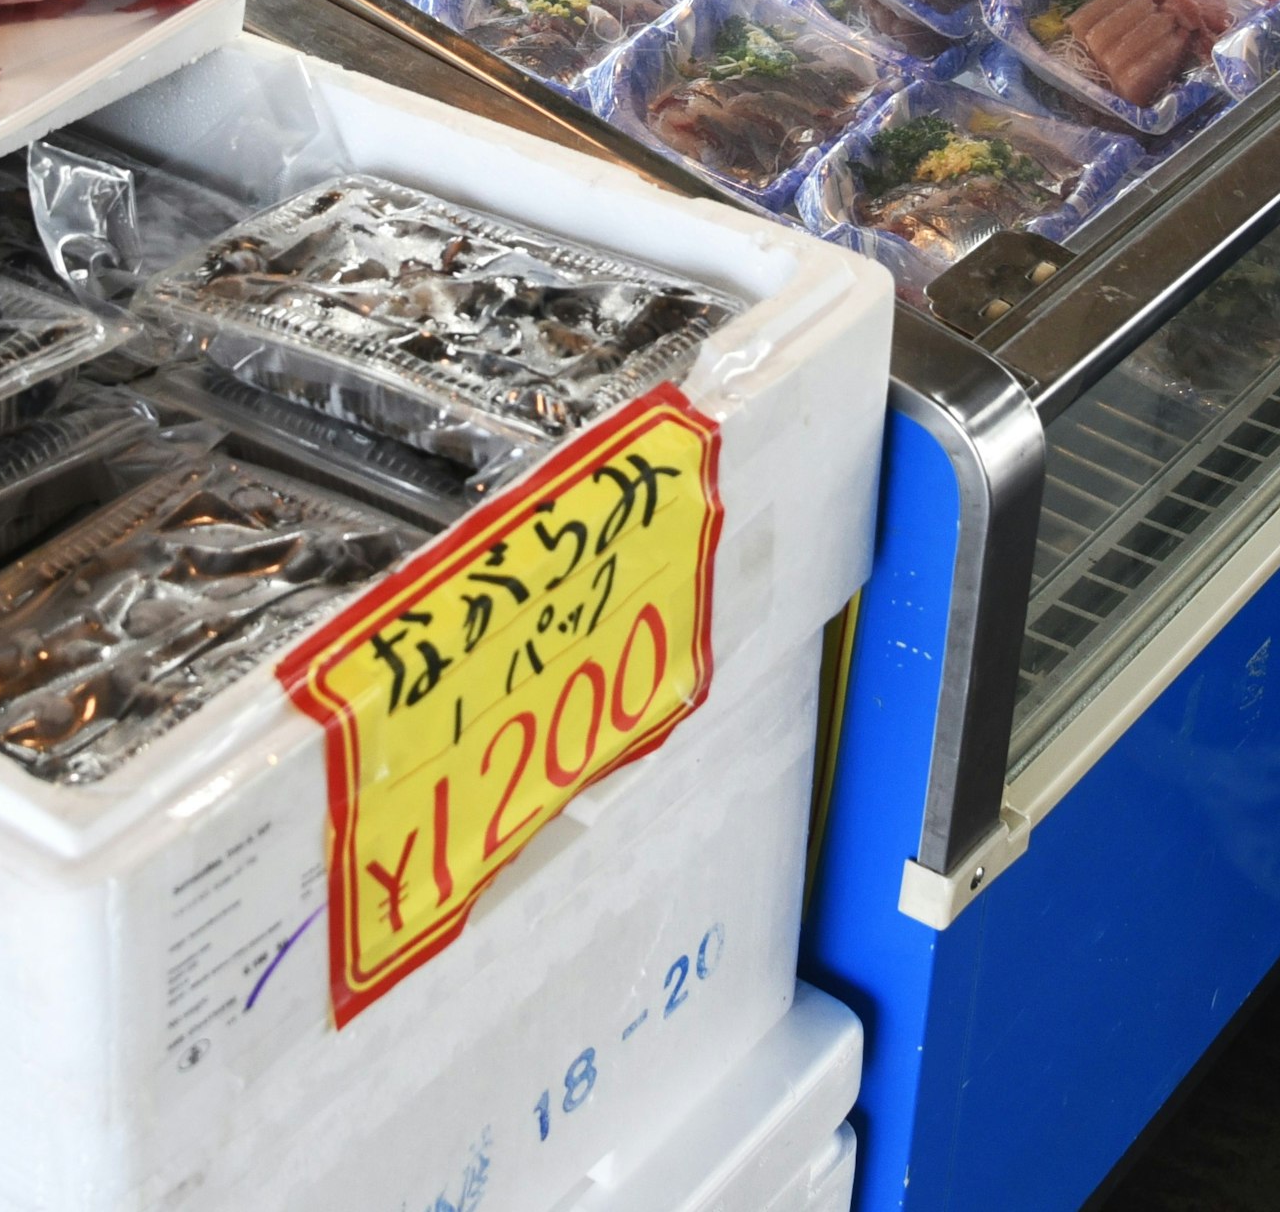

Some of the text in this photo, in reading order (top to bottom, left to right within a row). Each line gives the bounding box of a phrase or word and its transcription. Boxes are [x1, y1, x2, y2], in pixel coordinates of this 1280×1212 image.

[368, 452, 683, 717] ながらみ
[365, 602, 670, 934] ¥1200
